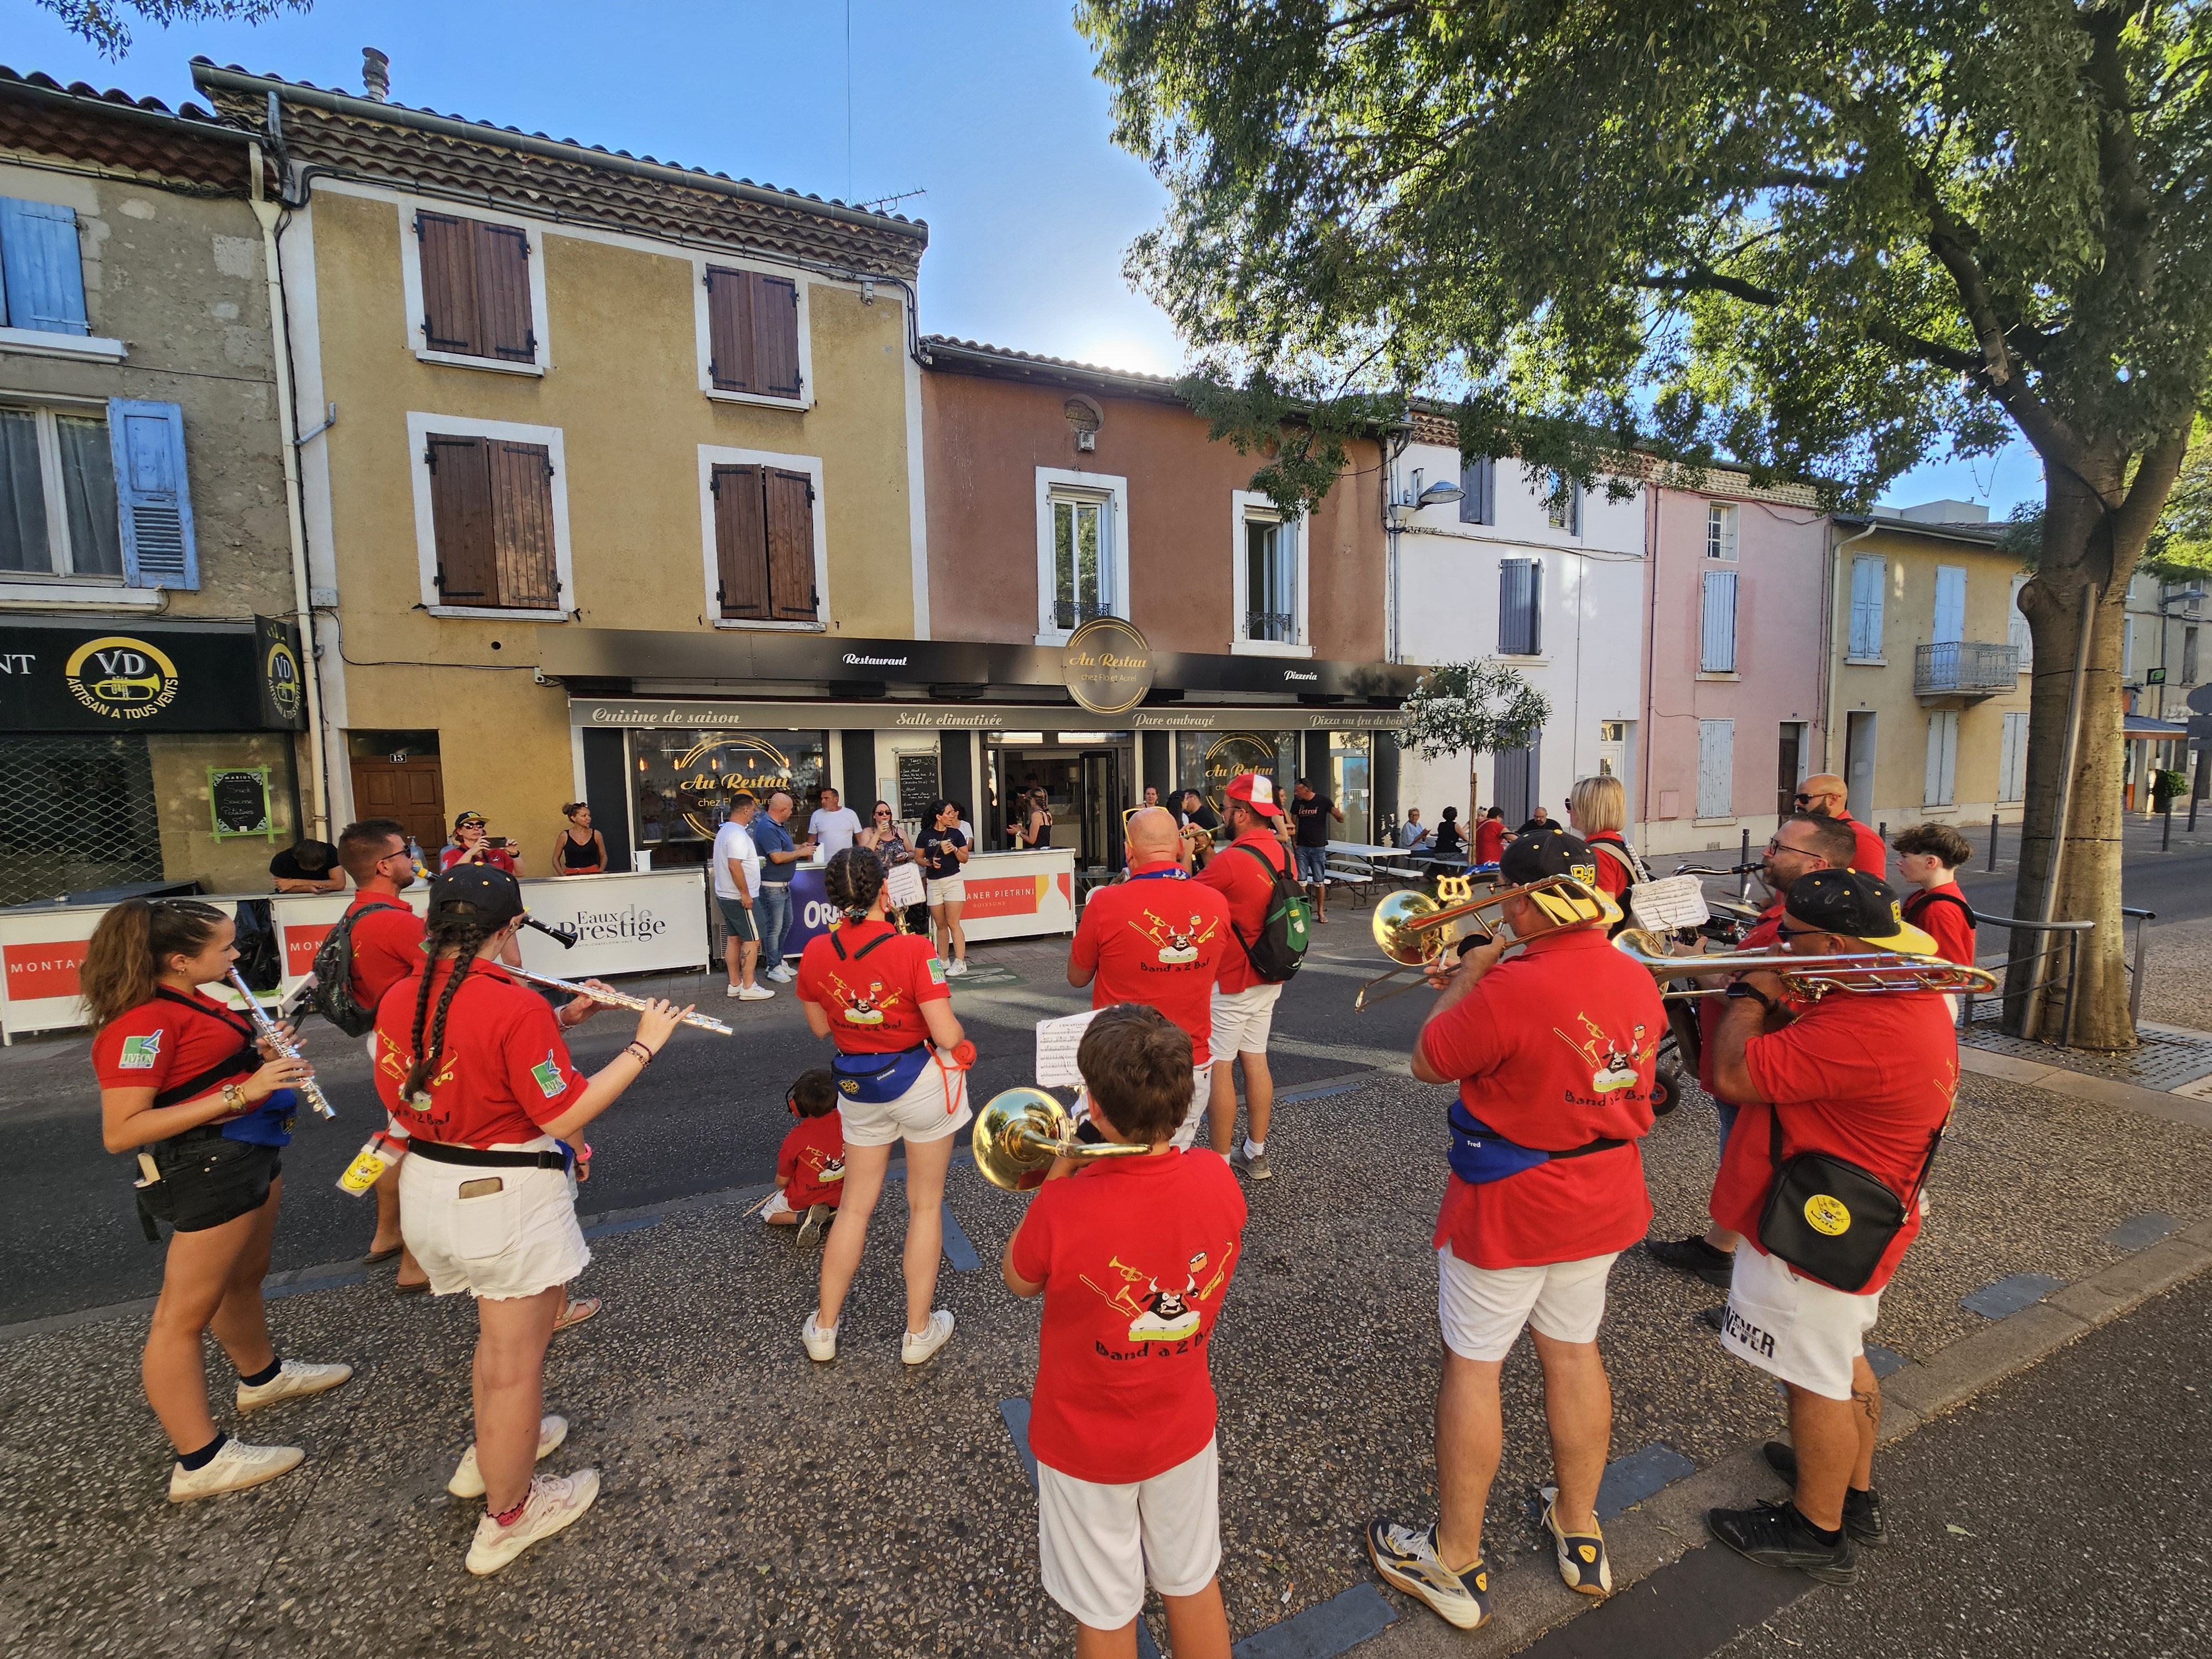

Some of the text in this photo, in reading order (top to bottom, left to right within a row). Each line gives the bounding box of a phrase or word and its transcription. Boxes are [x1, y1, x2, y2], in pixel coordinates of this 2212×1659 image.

[95, 649, 146, 675] VD
[843, 653, 907, 666] Restaurant
[1069, 652, 1147, 668] Au Restau
[275, 656, 290, 678] VD
[1284, 670, 1317, 681] Pizzeria
[66, 678, 179, 719] ARTISAN A TOUS VENTS
[592, 708, 741, 723] Cuisine de saison
[896, 712, 1003, 726] Salle climatisée
[1133, 713, 1215, 727] Parc ombragé
[1310, 714, 1340, 727] Pizza
[1357, 715, 1371, 727] feu
[1373, 716, 1384, 725] de
[1385, 716, 1404, 725] bois
[1206, 764, 1227, 777] Au
[680, 773, 791, 790] Au Restau
[698, 798, 721, 807] chez
[967, 888, 1035, 900] ANER PIETRINI
[577, 904, 653, 926] Eaux de
[1194, 957, 1210, 969] Bal
[1467, 1140, 1481, 1148] Fred
[1723, 1305, 1775, 1359] NEVER
[1176, 1340, 1188, 1354] 2
